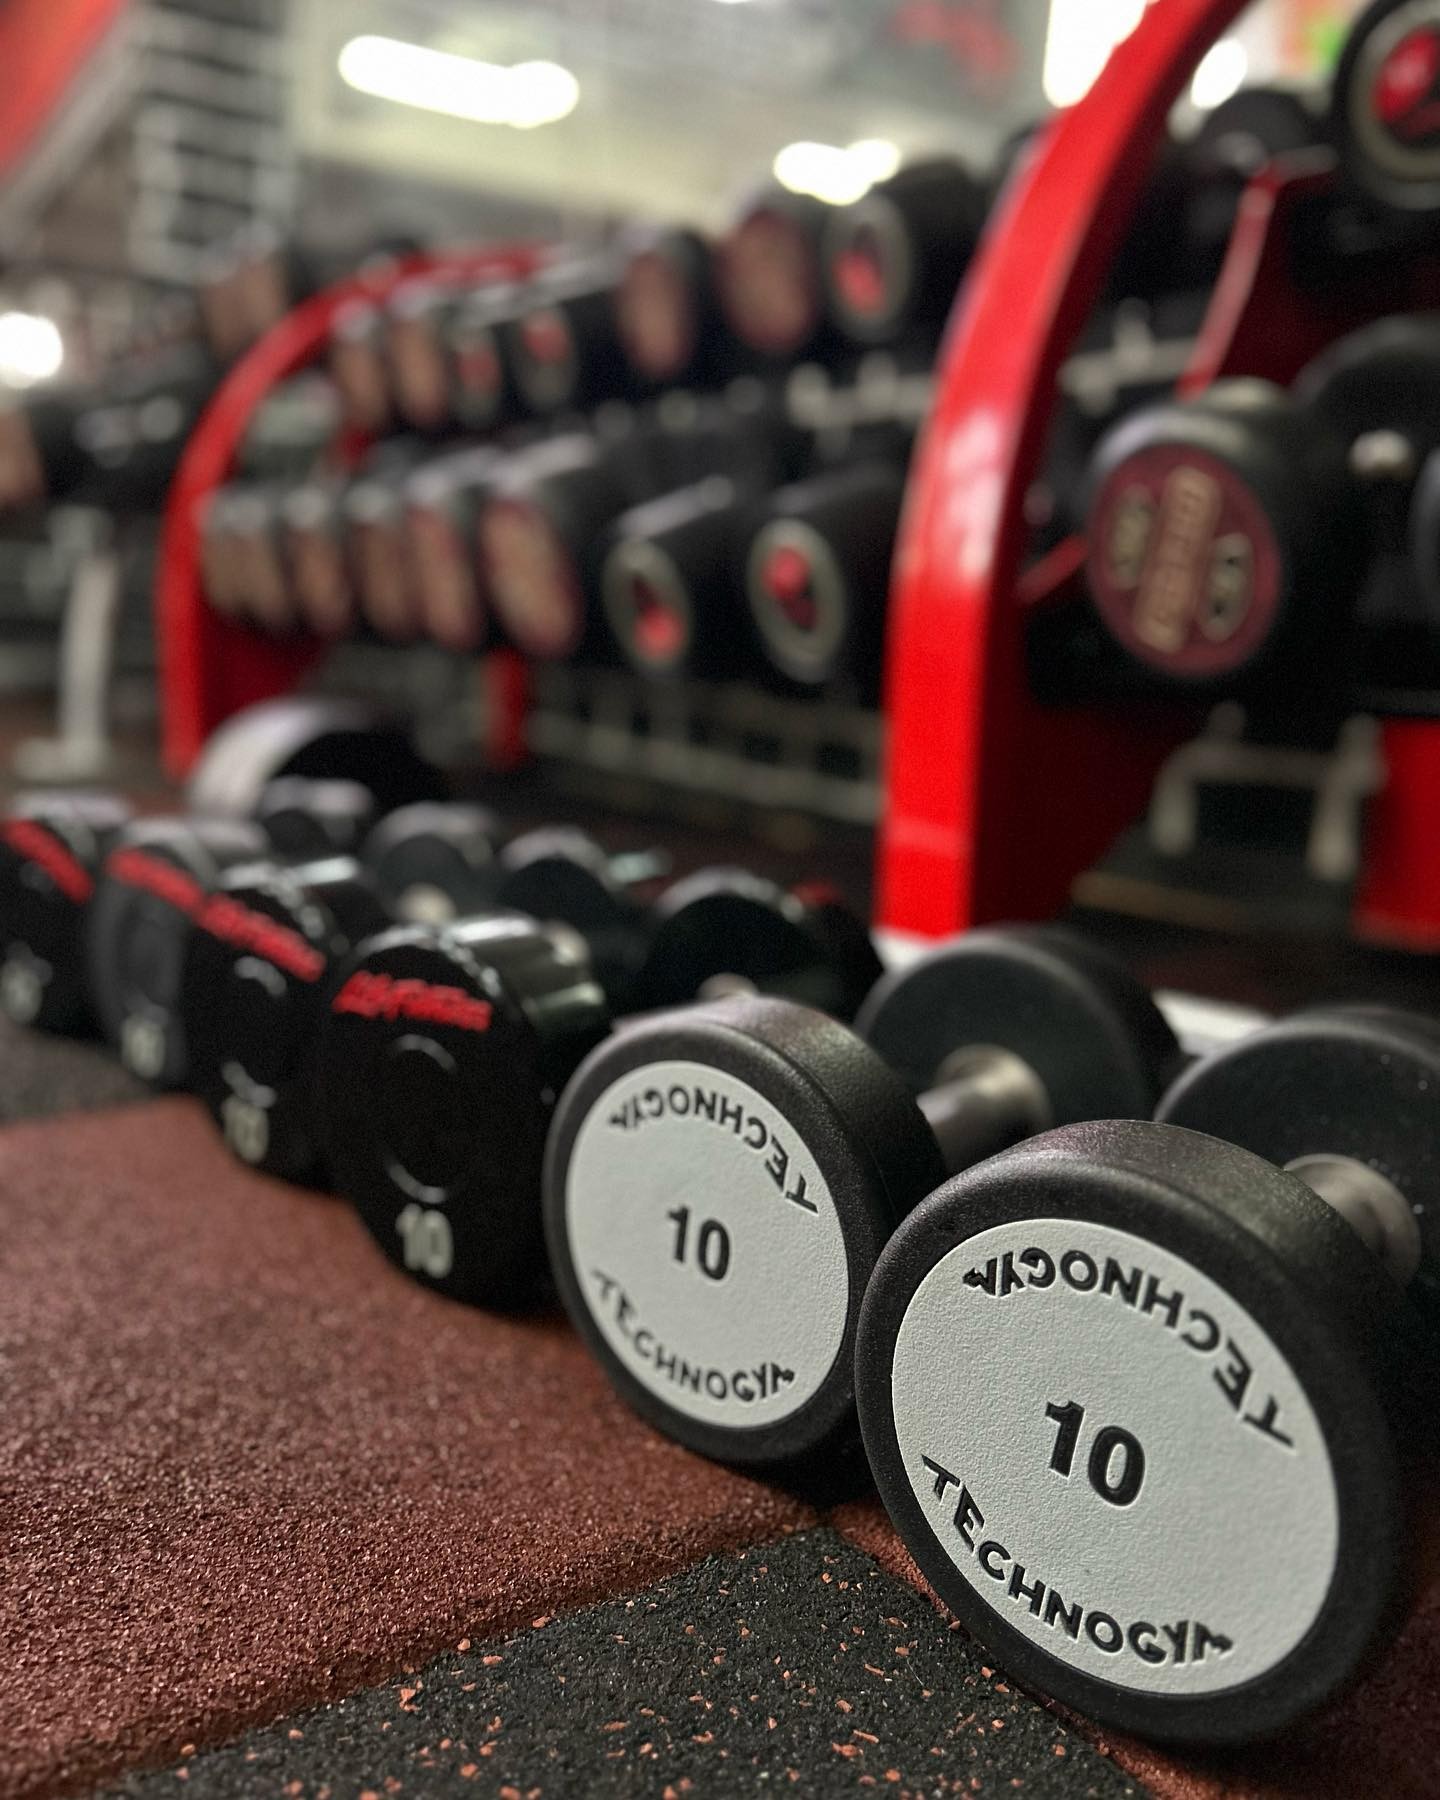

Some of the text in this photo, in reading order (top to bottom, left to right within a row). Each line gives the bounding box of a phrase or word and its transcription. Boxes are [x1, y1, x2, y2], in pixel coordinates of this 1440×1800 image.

[609, 1085, 818, 1215] TECHNOGYM
[667, 1204, 730, 1281] 10
[591, 1271, 795, 1402] TECHNOGYM
[962, 1246, 1295, 1450] TECHNOGYM
[1044, 1399, 1146, 1507] 10
[922, 1455, 1233, 1665] TECHNOGYM
